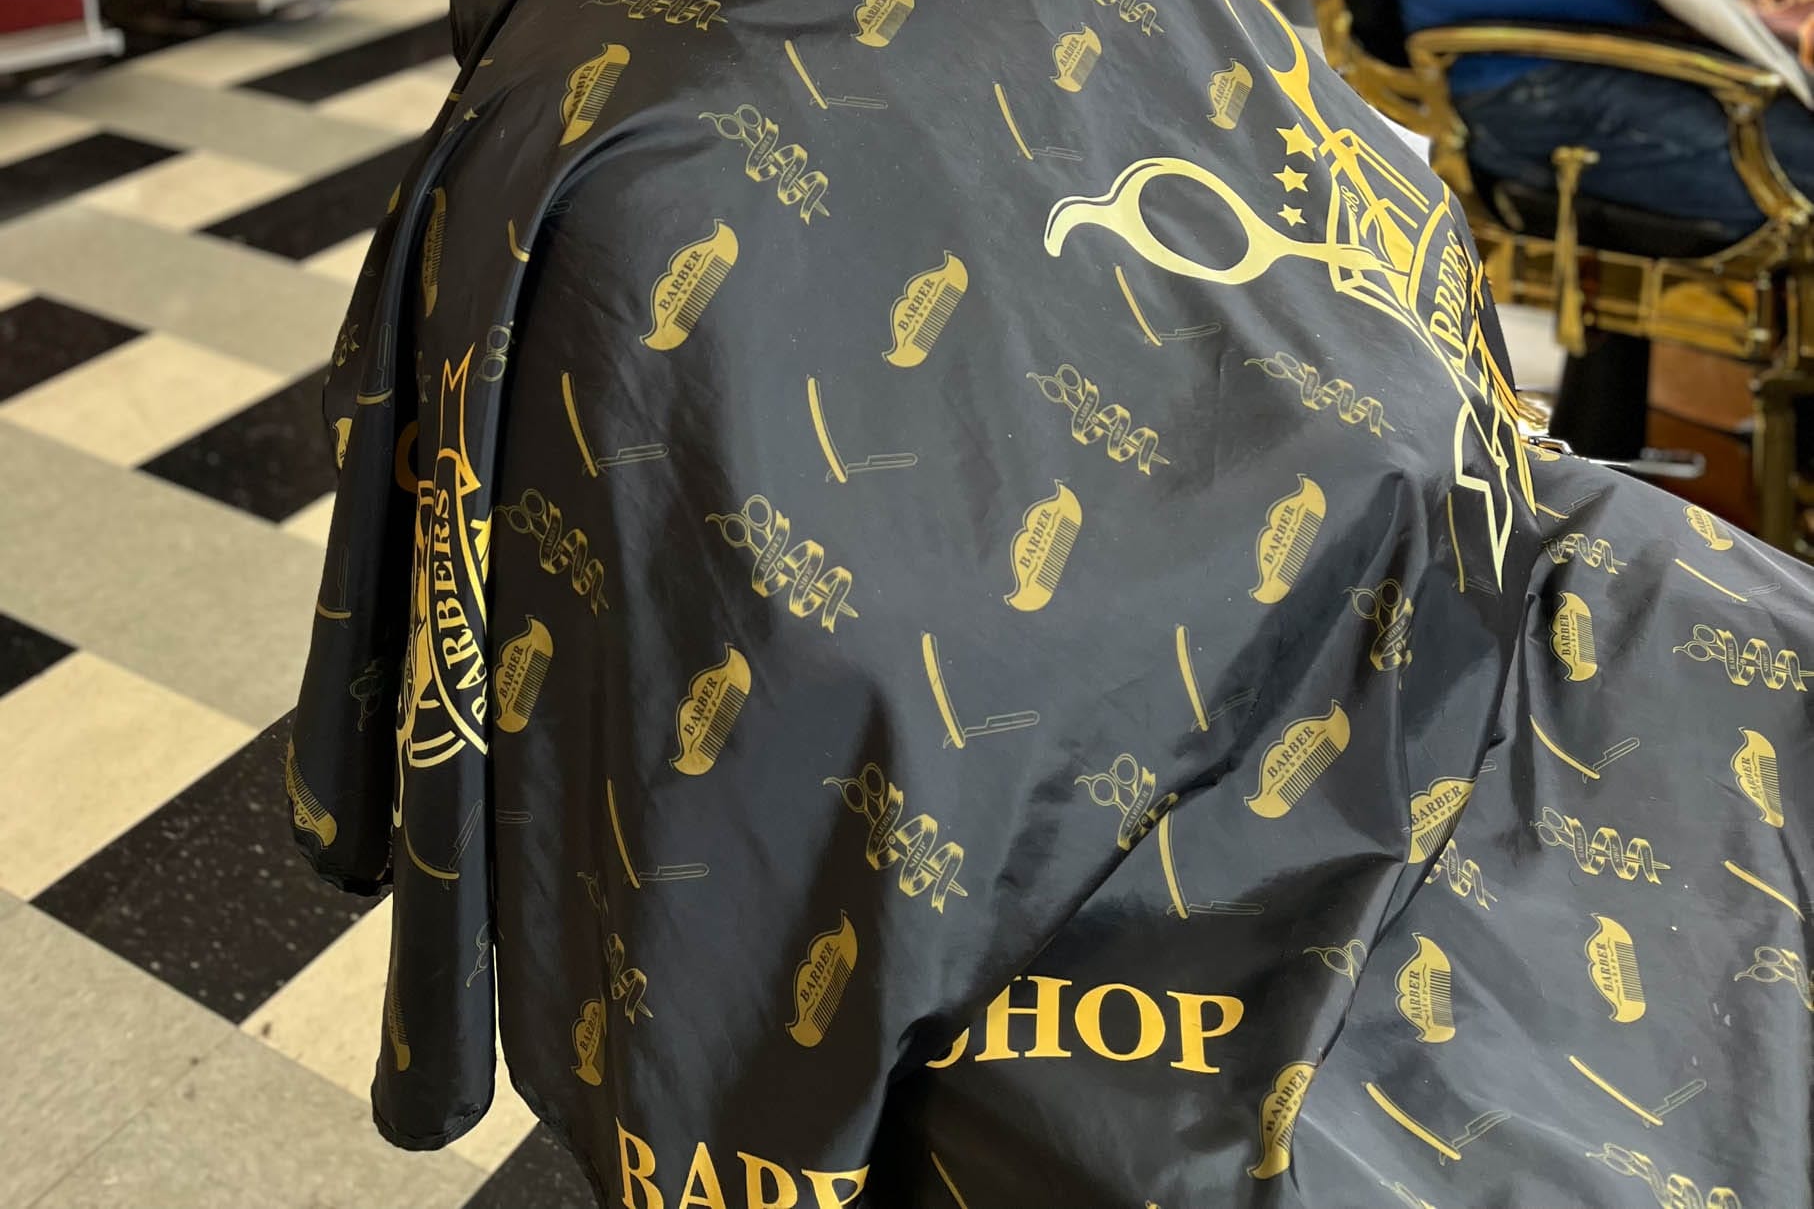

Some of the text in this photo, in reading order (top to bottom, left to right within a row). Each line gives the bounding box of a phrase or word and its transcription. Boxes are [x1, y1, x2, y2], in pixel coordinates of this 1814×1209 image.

[658, 249, 702, 311] BARBER
[897, 277, 936, 332] BARBER
[1019, 508, 1052, 569] BARBER
[1263, 504, 1296, 565] BARBER
[1559, 613, 1571, 656] BARBER
[500, 644, 525, 699] BARBER
[683, 676, 718, 736] BARBER
[1267, 725, 1315, 779] BARBER
[1410, 785, 1463, 826] BARBER
[800, 941, 834, 1003] BARBER
[1408, 970, 1423, 1020] BARBER
[1595, 942, 1615, 993] BARBER
[925, 975, 1245, 1074] HOP
[1265, 1069, 1309, 1132] BARBER
